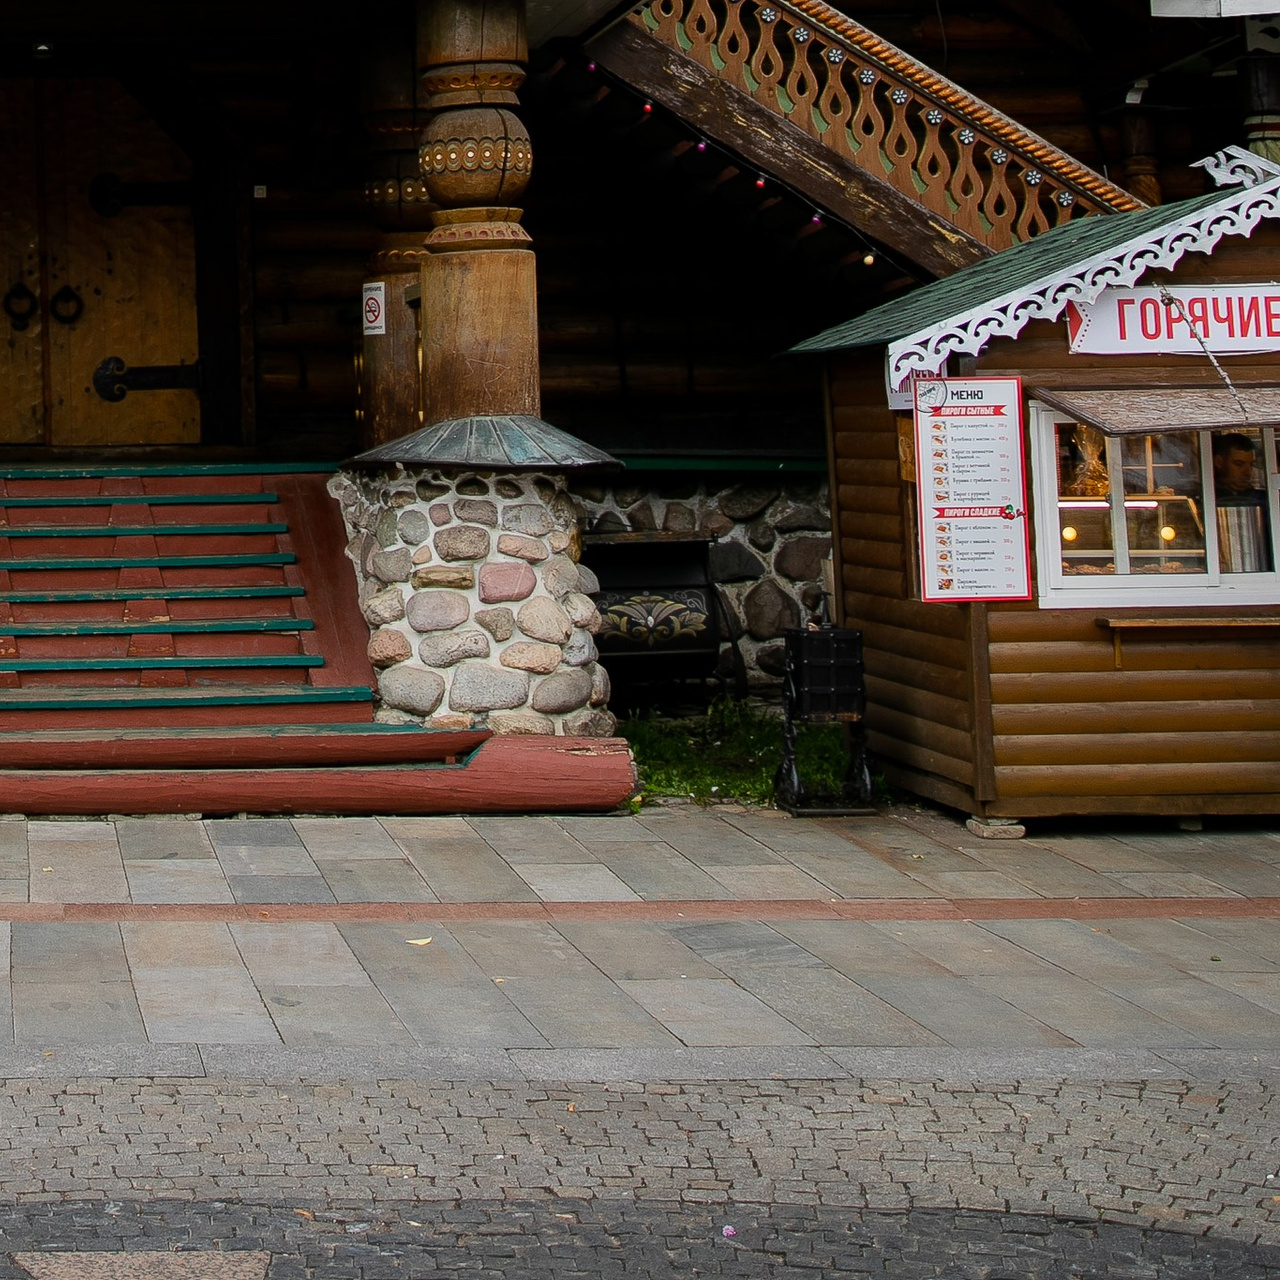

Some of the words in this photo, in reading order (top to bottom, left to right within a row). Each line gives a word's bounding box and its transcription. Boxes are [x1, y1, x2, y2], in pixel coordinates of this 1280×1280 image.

[1117, 296, 1280, 340] ГОРЯЧИЕ
[950, 390, 984, 400] МЕНЮ
[940, 406, 966, 415] ПИРОГИ
[966, 406, 995, 415] СЫТНЫЕ
[944, 508, 970, 517] ПИРОГИ
[970, 507, 1001, 516] СЛАДКИЕ
